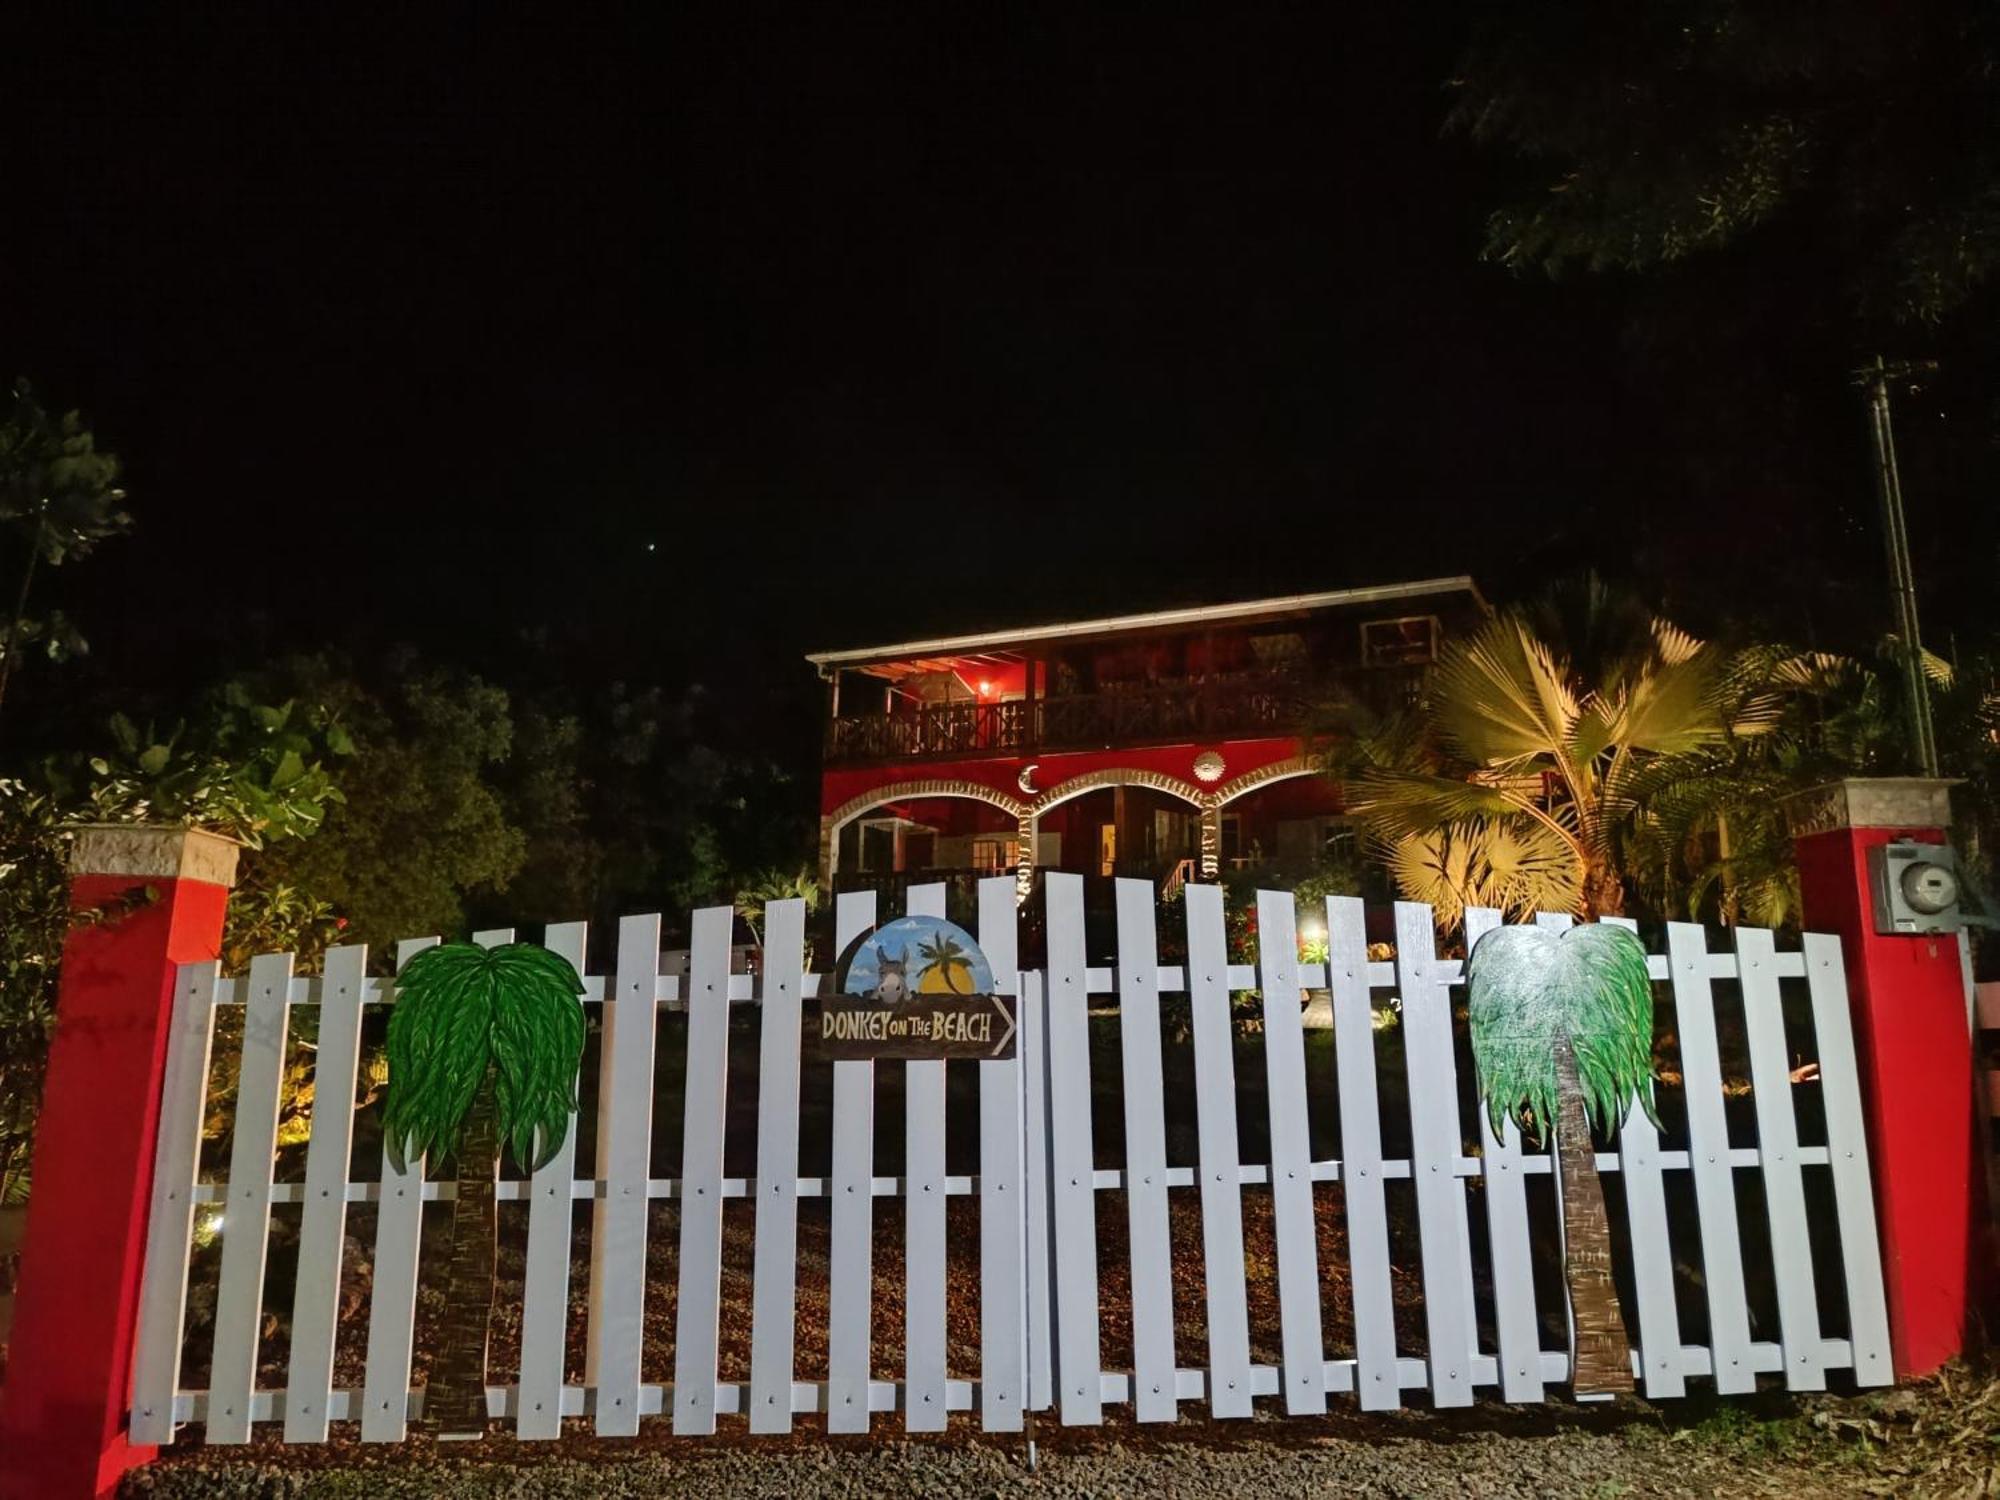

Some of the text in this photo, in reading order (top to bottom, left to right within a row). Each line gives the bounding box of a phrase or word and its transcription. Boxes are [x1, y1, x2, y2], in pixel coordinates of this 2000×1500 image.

[823, 1011, 893, 1041] DONKEY
[889, 1020, 908, 1036] ON
[930, 1011, 992, 1042] BEACH
